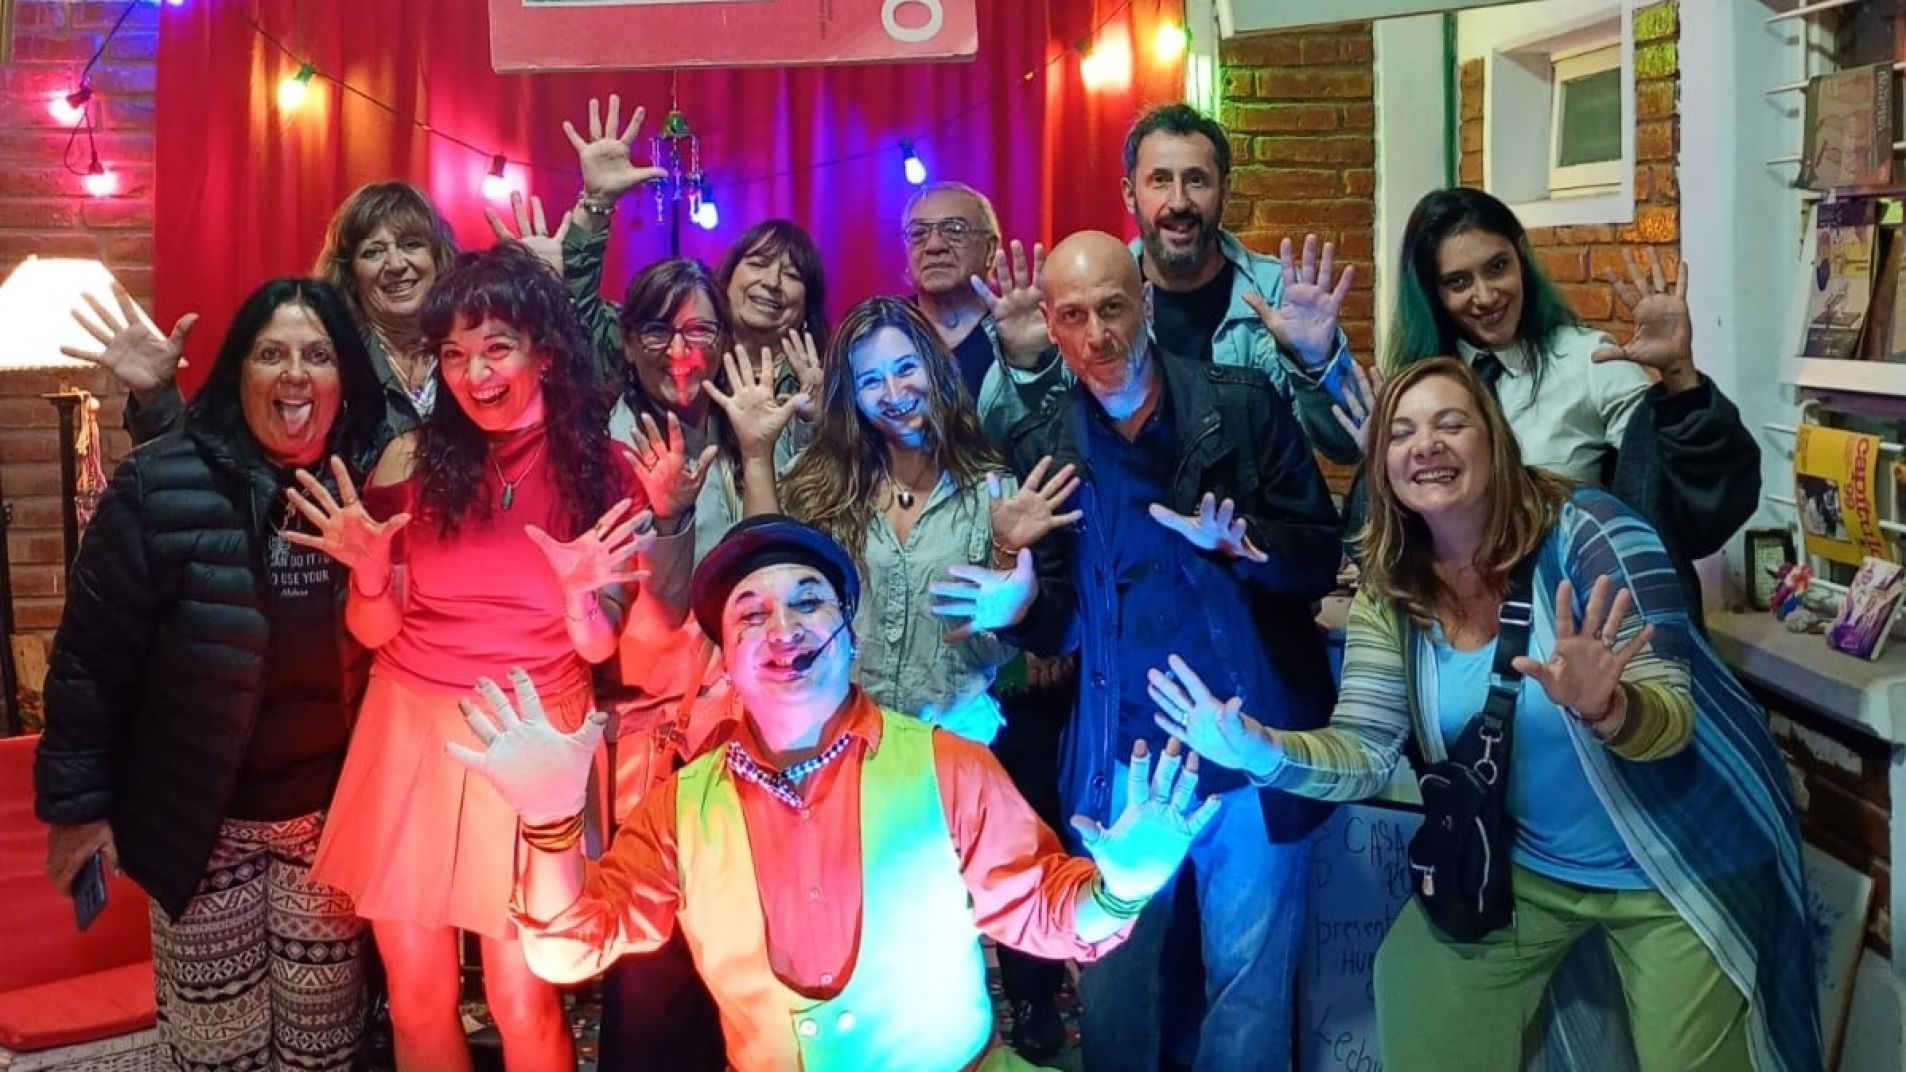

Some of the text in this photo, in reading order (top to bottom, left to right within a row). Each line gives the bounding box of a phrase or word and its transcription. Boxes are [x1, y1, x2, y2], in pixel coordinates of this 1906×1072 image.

[290, 555, 303, 567] DO
[281, 571, 300, 585] USE
[303, 569, 330, 584] YOUR
[1345, 816, 1411, 867] CASA
